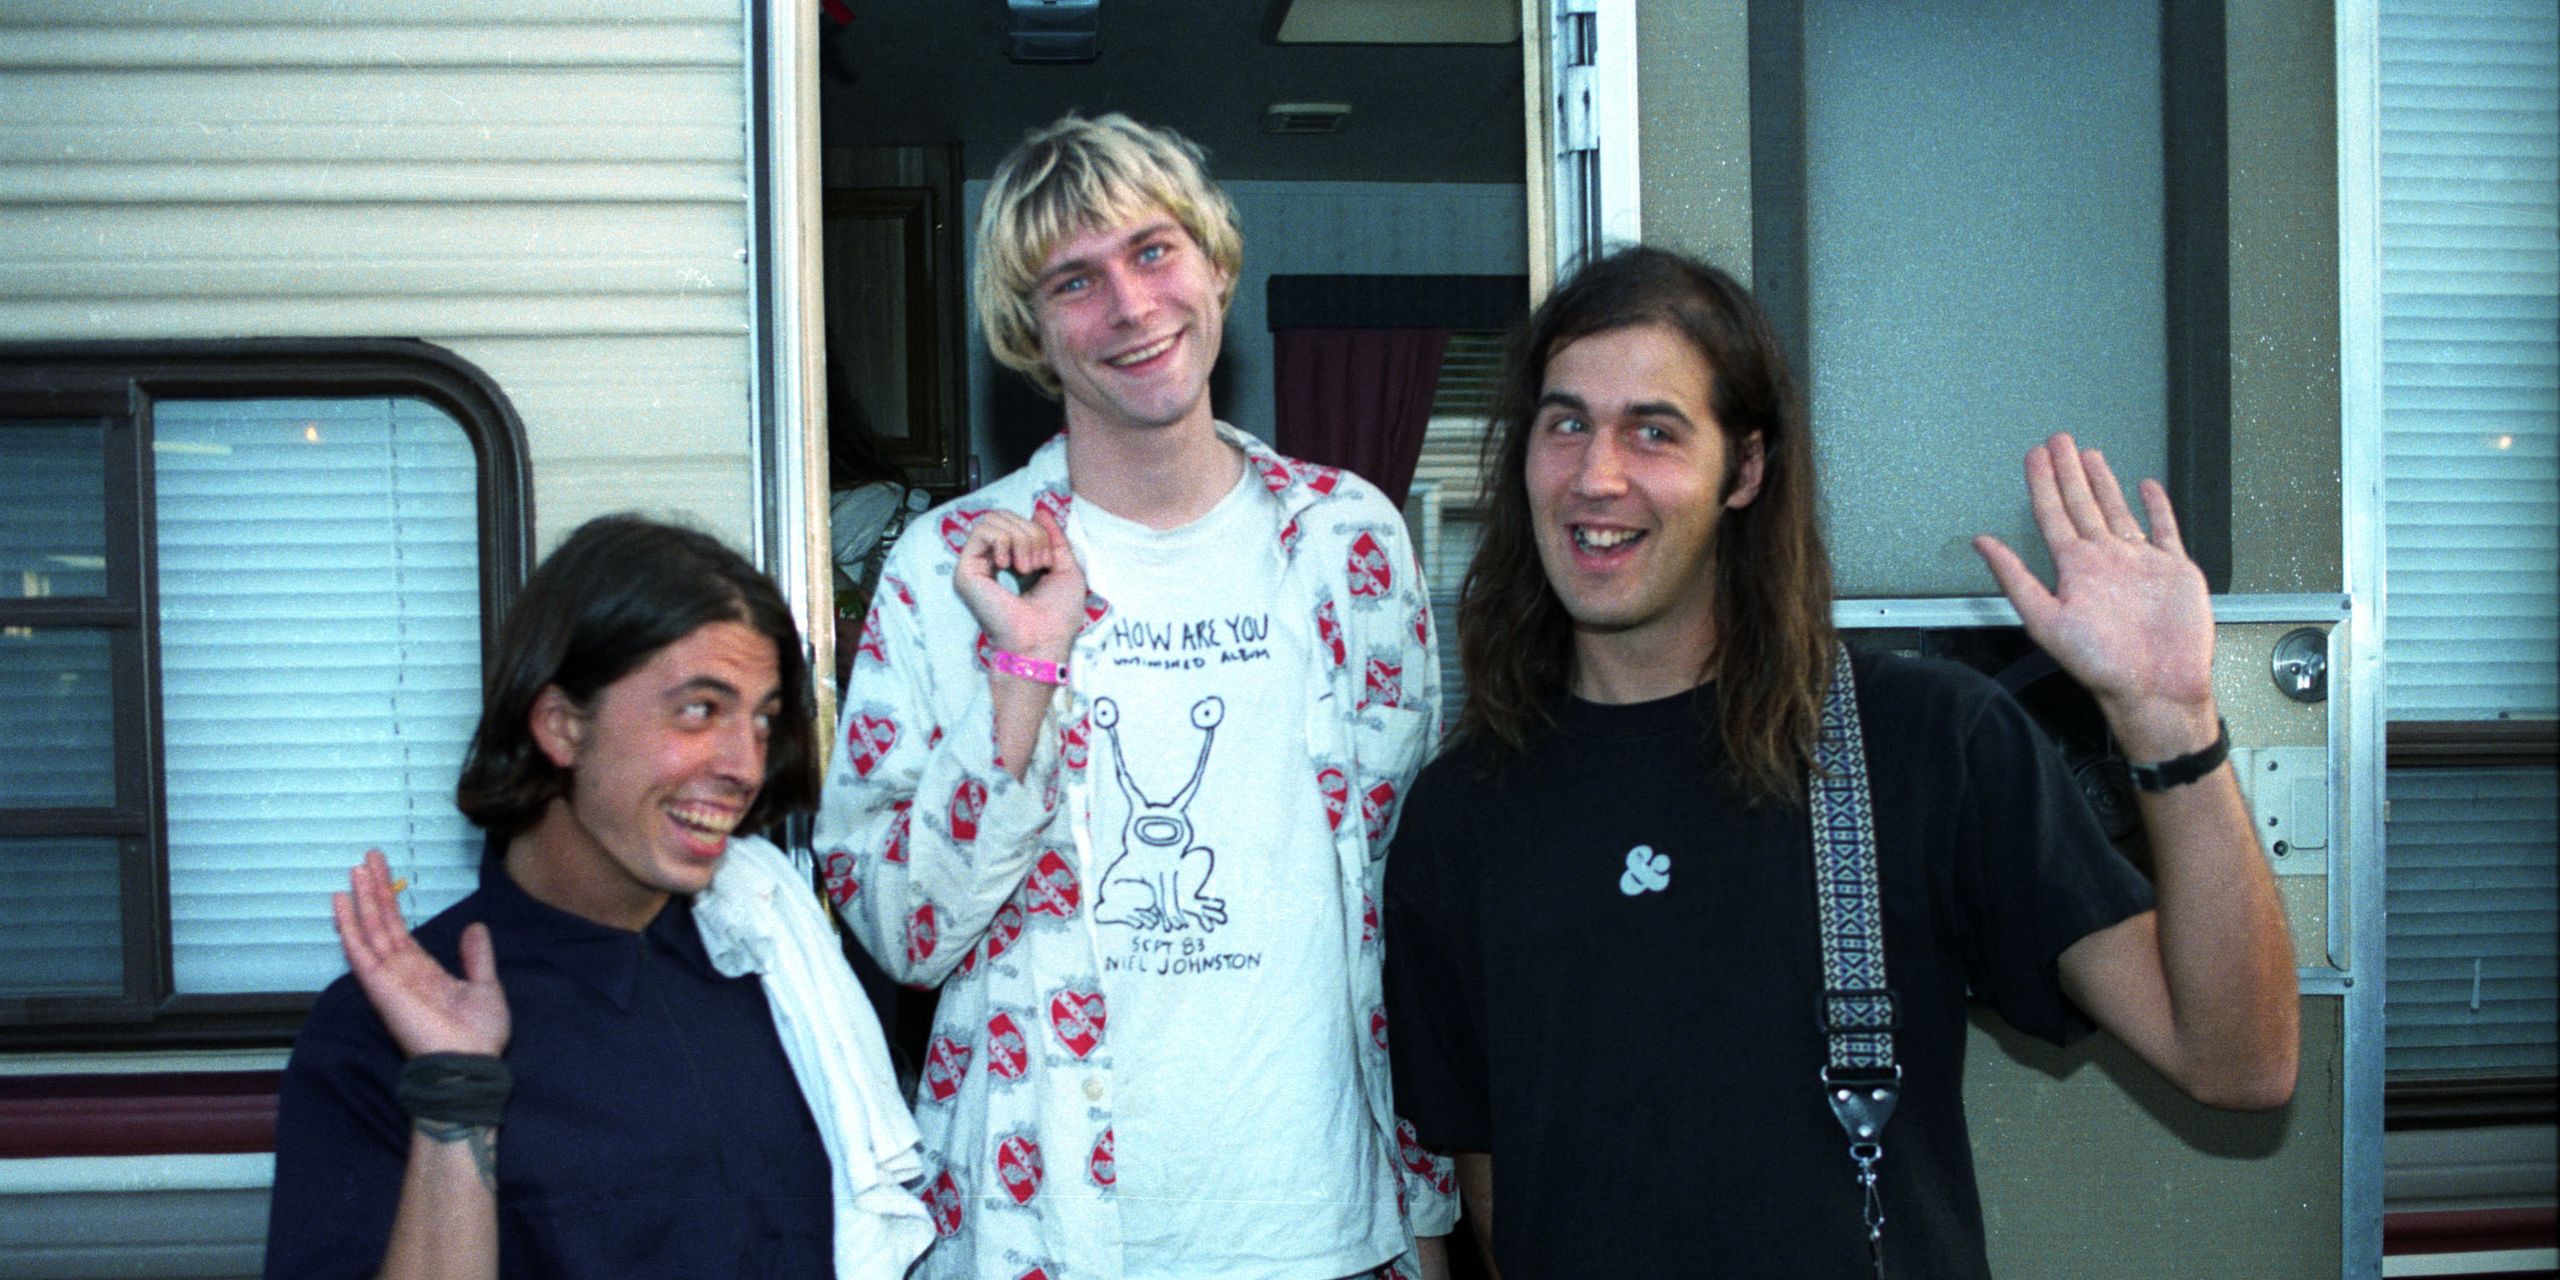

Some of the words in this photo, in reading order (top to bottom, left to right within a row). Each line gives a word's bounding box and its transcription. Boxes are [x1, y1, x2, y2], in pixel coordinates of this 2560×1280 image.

[1113, 616, 1171, 651] HOW
[1181, 618, 1221, 651] ARE
[1225, 613, 1269, 643] YOU
[1220, 648, 1271, 664] ALBUM
[1131, 935, 1174, 955] SEPT
[1182, 937, 1206, 956] 83
[1104, 955, 1147, 973] NIEL
[1157, 953, 1262, 976] JOHNSTON
